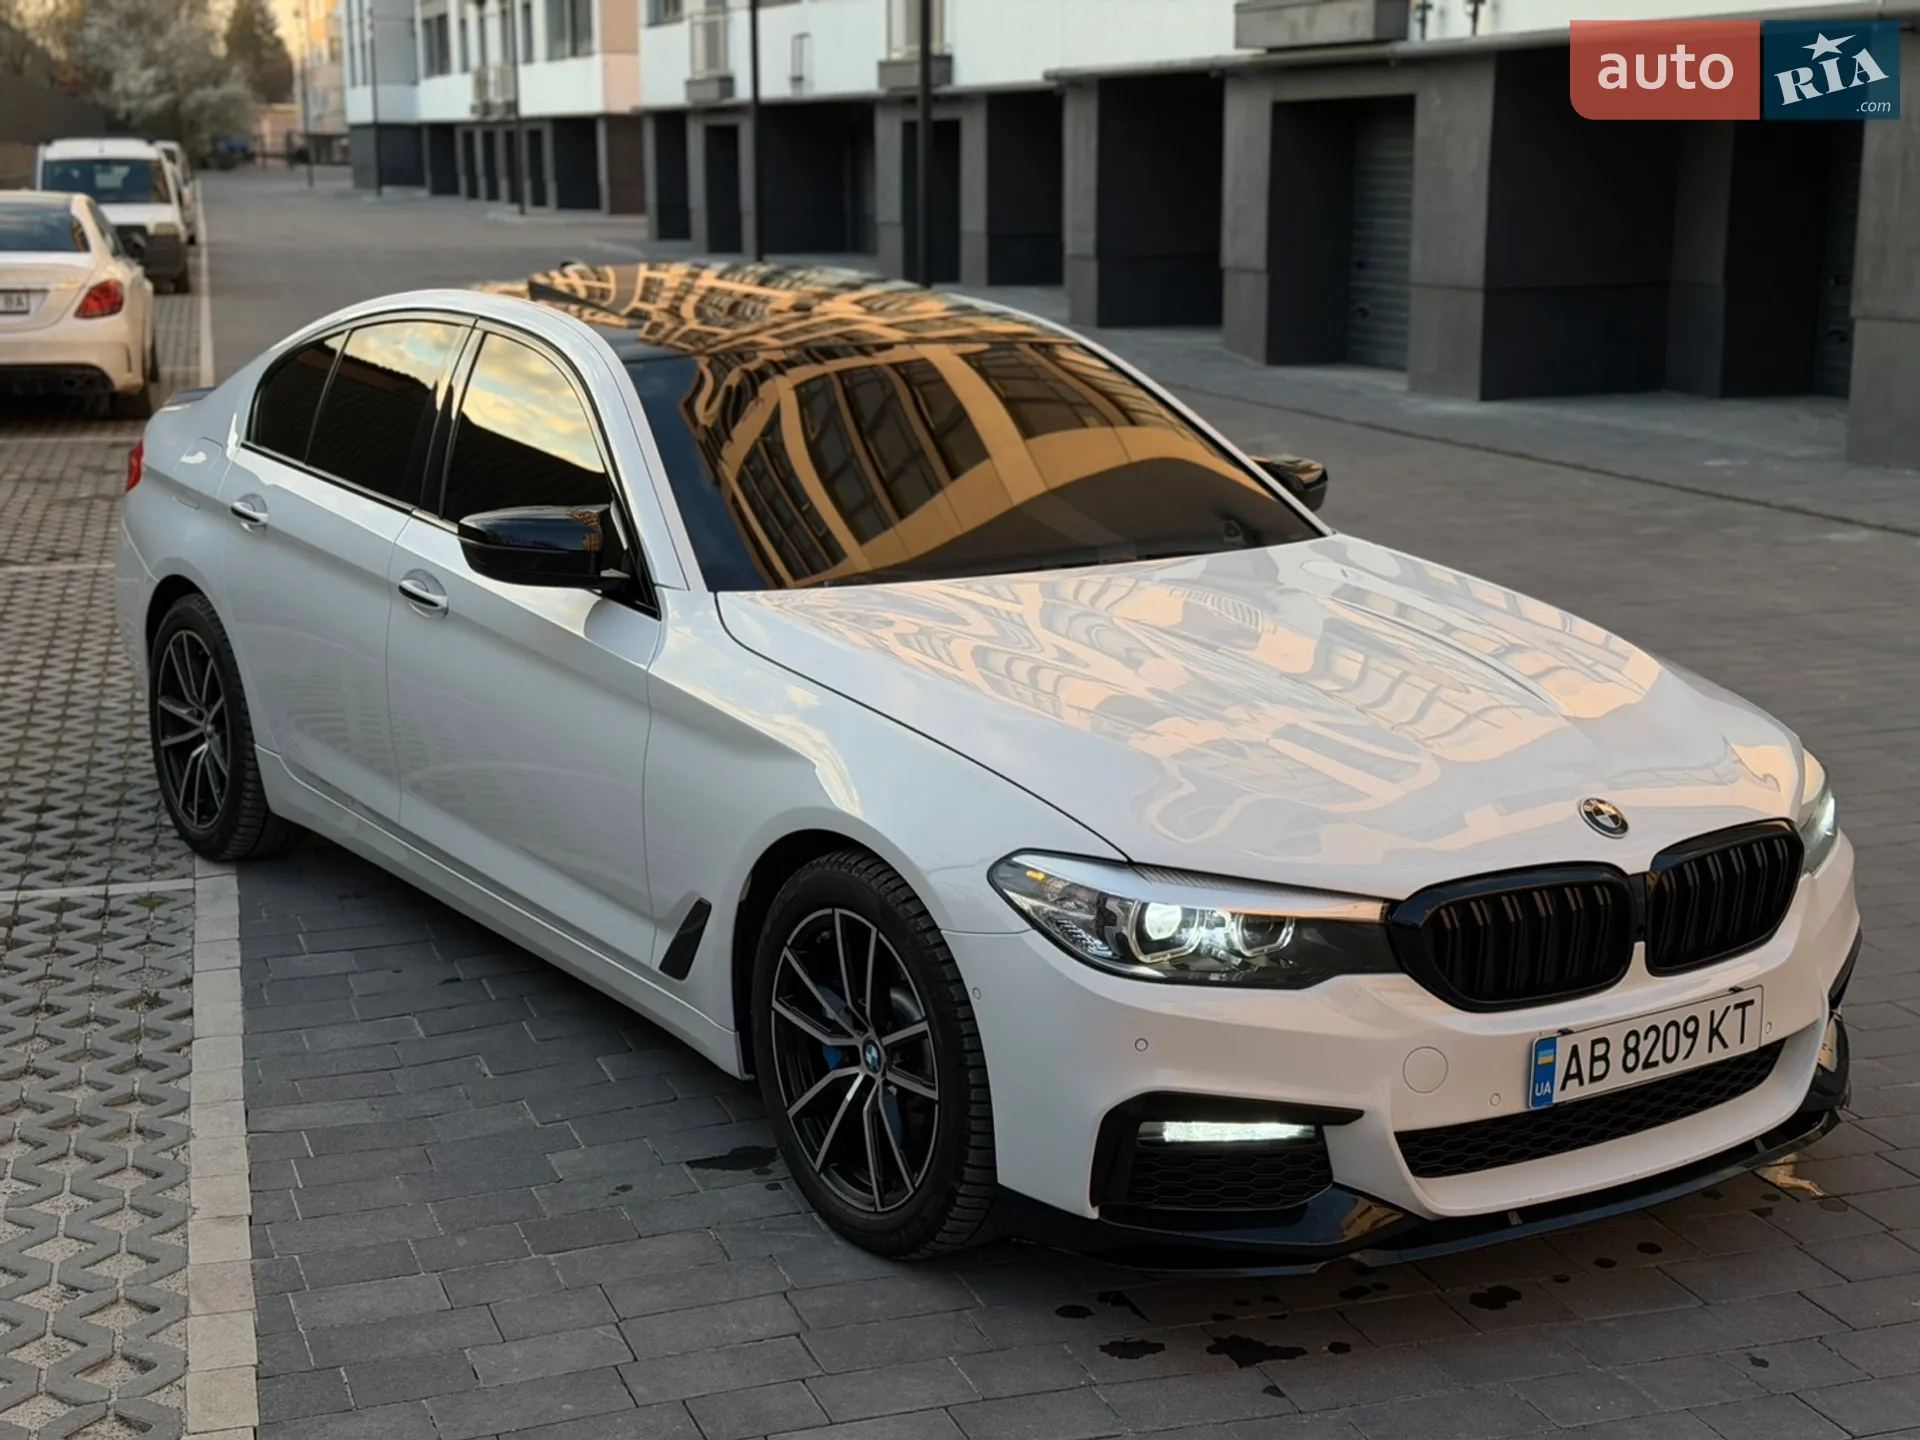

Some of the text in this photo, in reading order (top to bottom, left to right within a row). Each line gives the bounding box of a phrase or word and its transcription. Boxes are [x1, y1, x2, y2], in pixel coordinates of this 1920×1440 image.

[1560, 999, 1755, 1092] AB 8209 KT
[1535, 1081, 1552, 1097] UA
